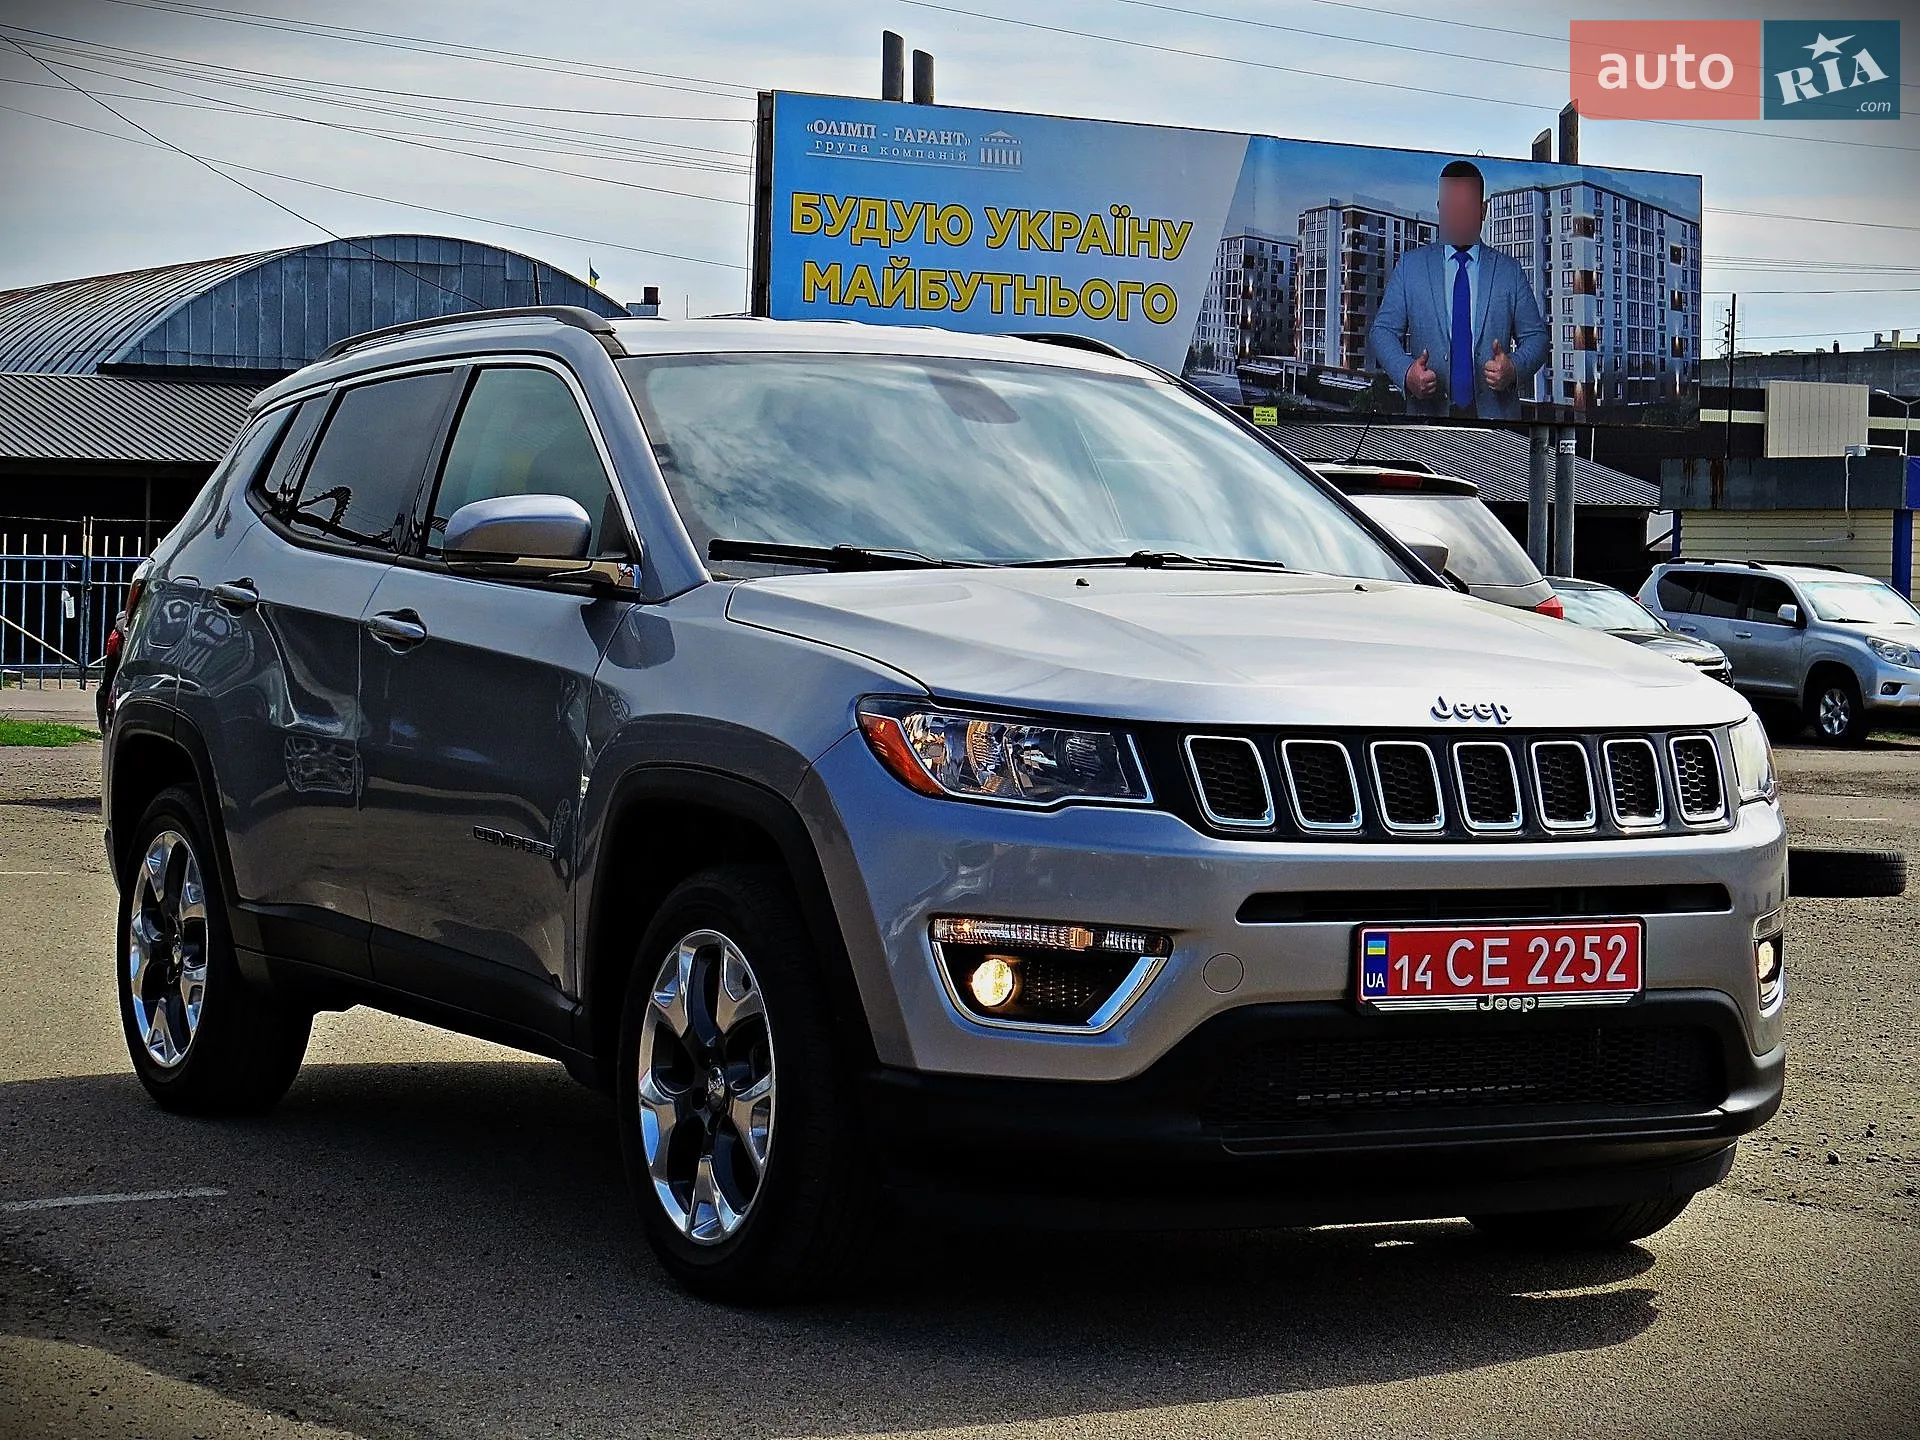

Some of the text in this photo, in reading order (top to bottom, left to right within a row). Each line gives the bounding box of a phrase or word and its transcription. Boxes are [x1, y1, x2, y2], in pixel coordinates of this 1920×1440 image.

[806, 119, 877, 140] «ОЛІМП
[815, 140, 967, 161] група компаній
[791, 192, 1193, 261] БУДУЮ УКРАЇНУ
[802, 256, 1178, 324] МАЙБУТНЬОГО
[1429, 695, 1513, 726] Jeep
[1394, 934, 1628, 990] 14 CE 2252
[1366, 972, 1385, 988] UA
[1479, 994, 1536, 1012] Jeep
